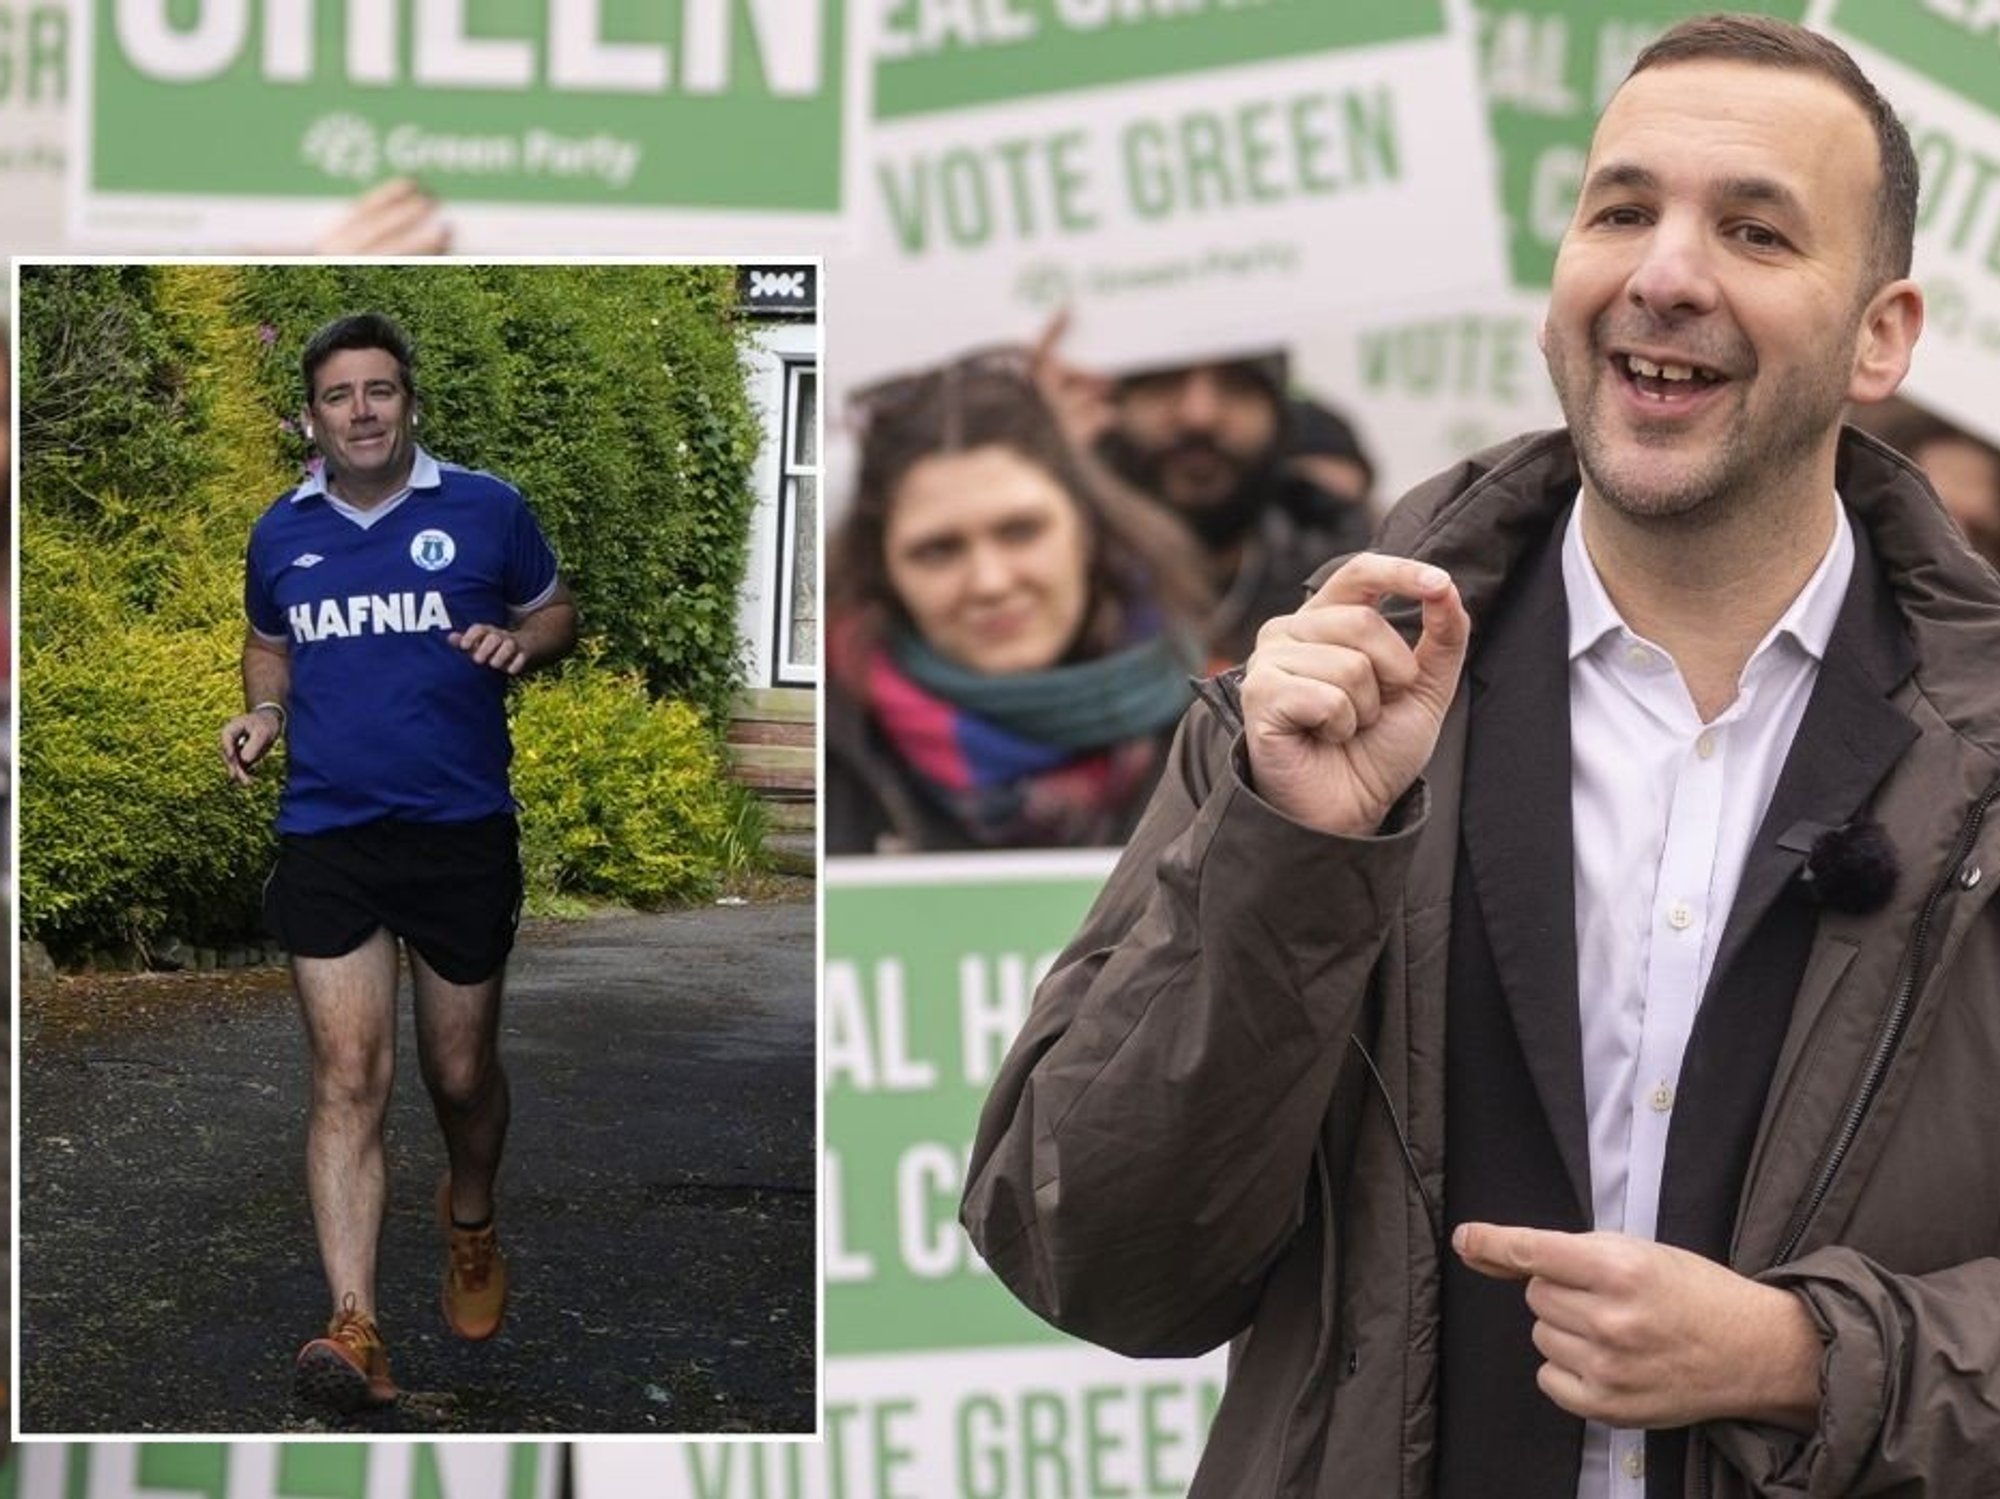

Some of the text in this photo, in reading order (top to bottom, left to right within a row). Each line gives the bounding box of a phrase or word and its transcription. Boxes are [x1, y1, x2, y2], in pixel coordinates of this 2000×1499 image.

[386, 124, 641, 189] Green Party
[876, 128, 1101, 255] VOTE
[1119, 83, 1403, 221] GREEN
[289, 590, 452, 644] HAFNIA
